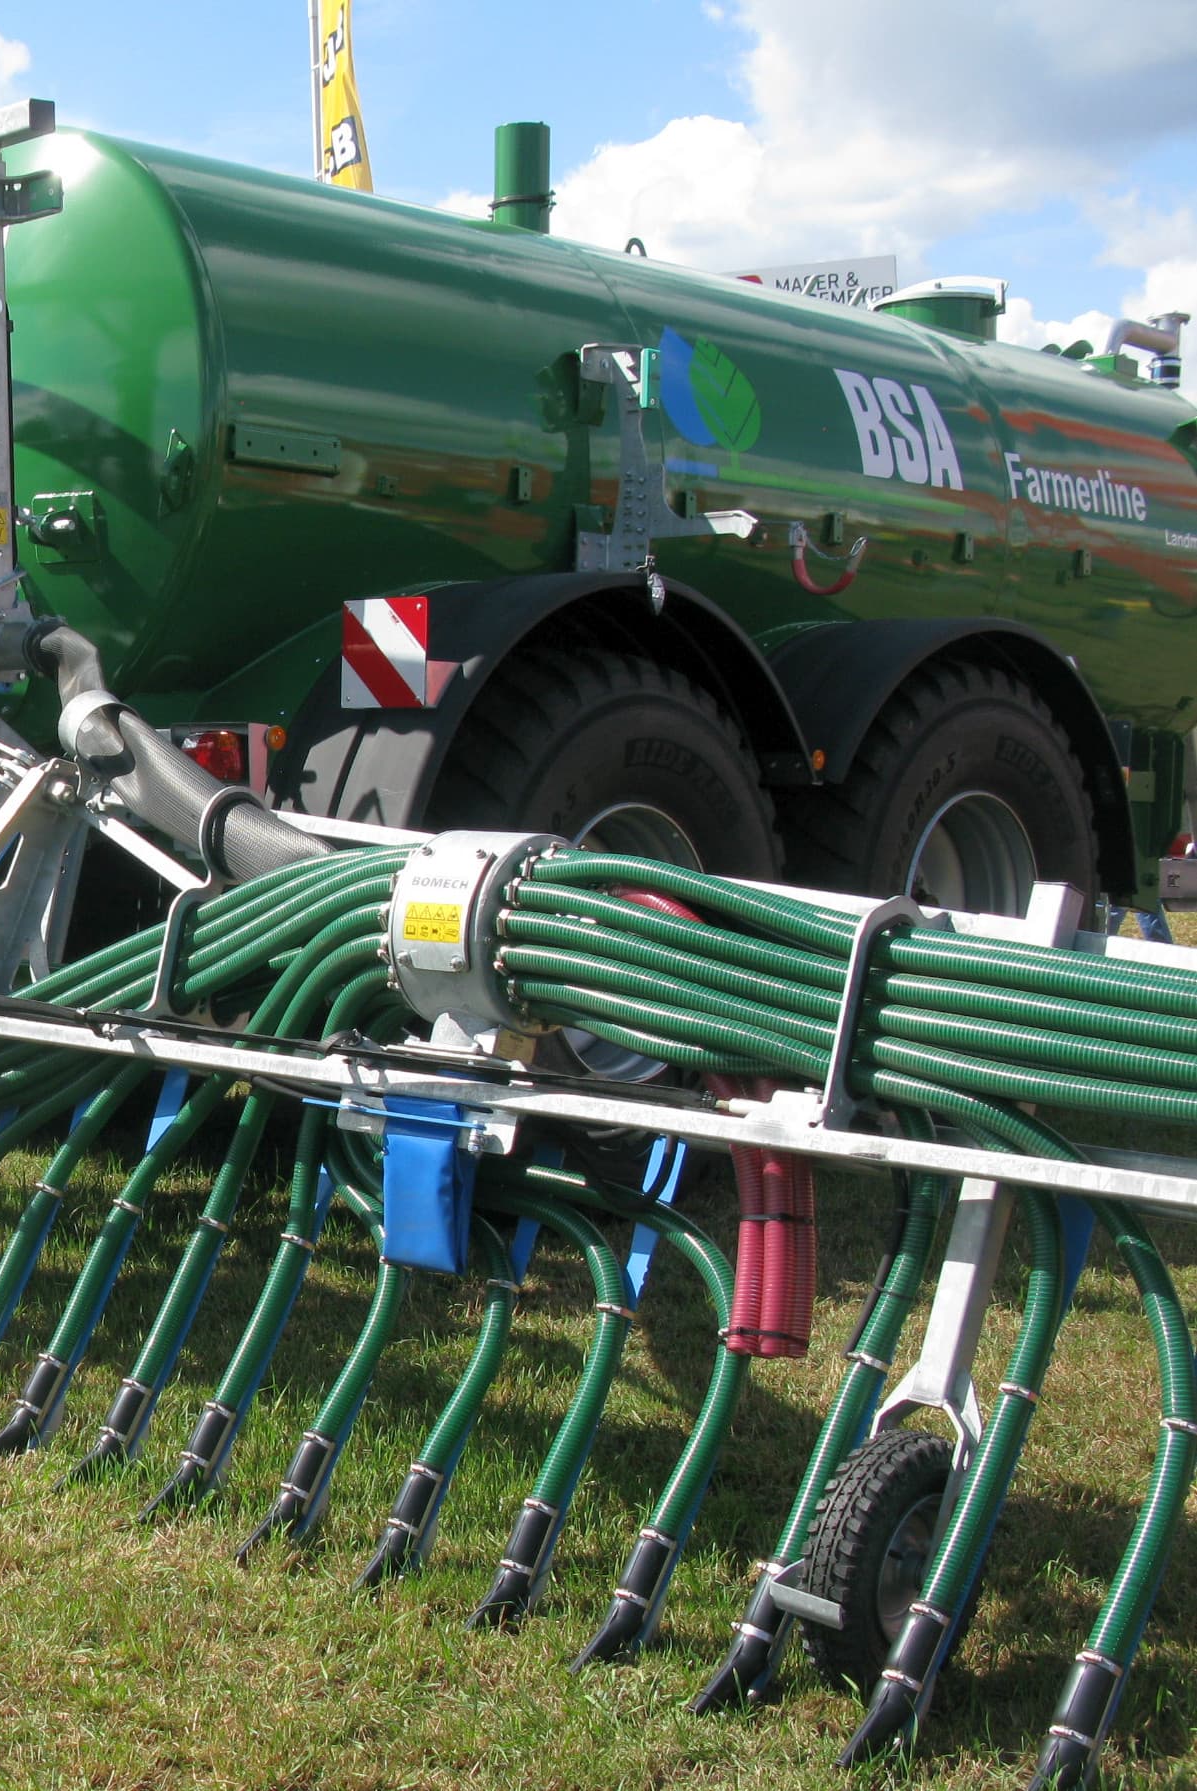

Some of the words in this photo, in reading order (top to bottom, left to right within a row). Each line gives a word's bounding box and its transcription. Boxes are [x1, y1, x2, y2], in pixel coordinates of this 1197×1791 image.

[846, 271, 859, 287] &
[833, 368, 964, 491] BSA
[1004, 452, 1147, 521] Farmerline
[412, 876, 469, 889] BOMECH
